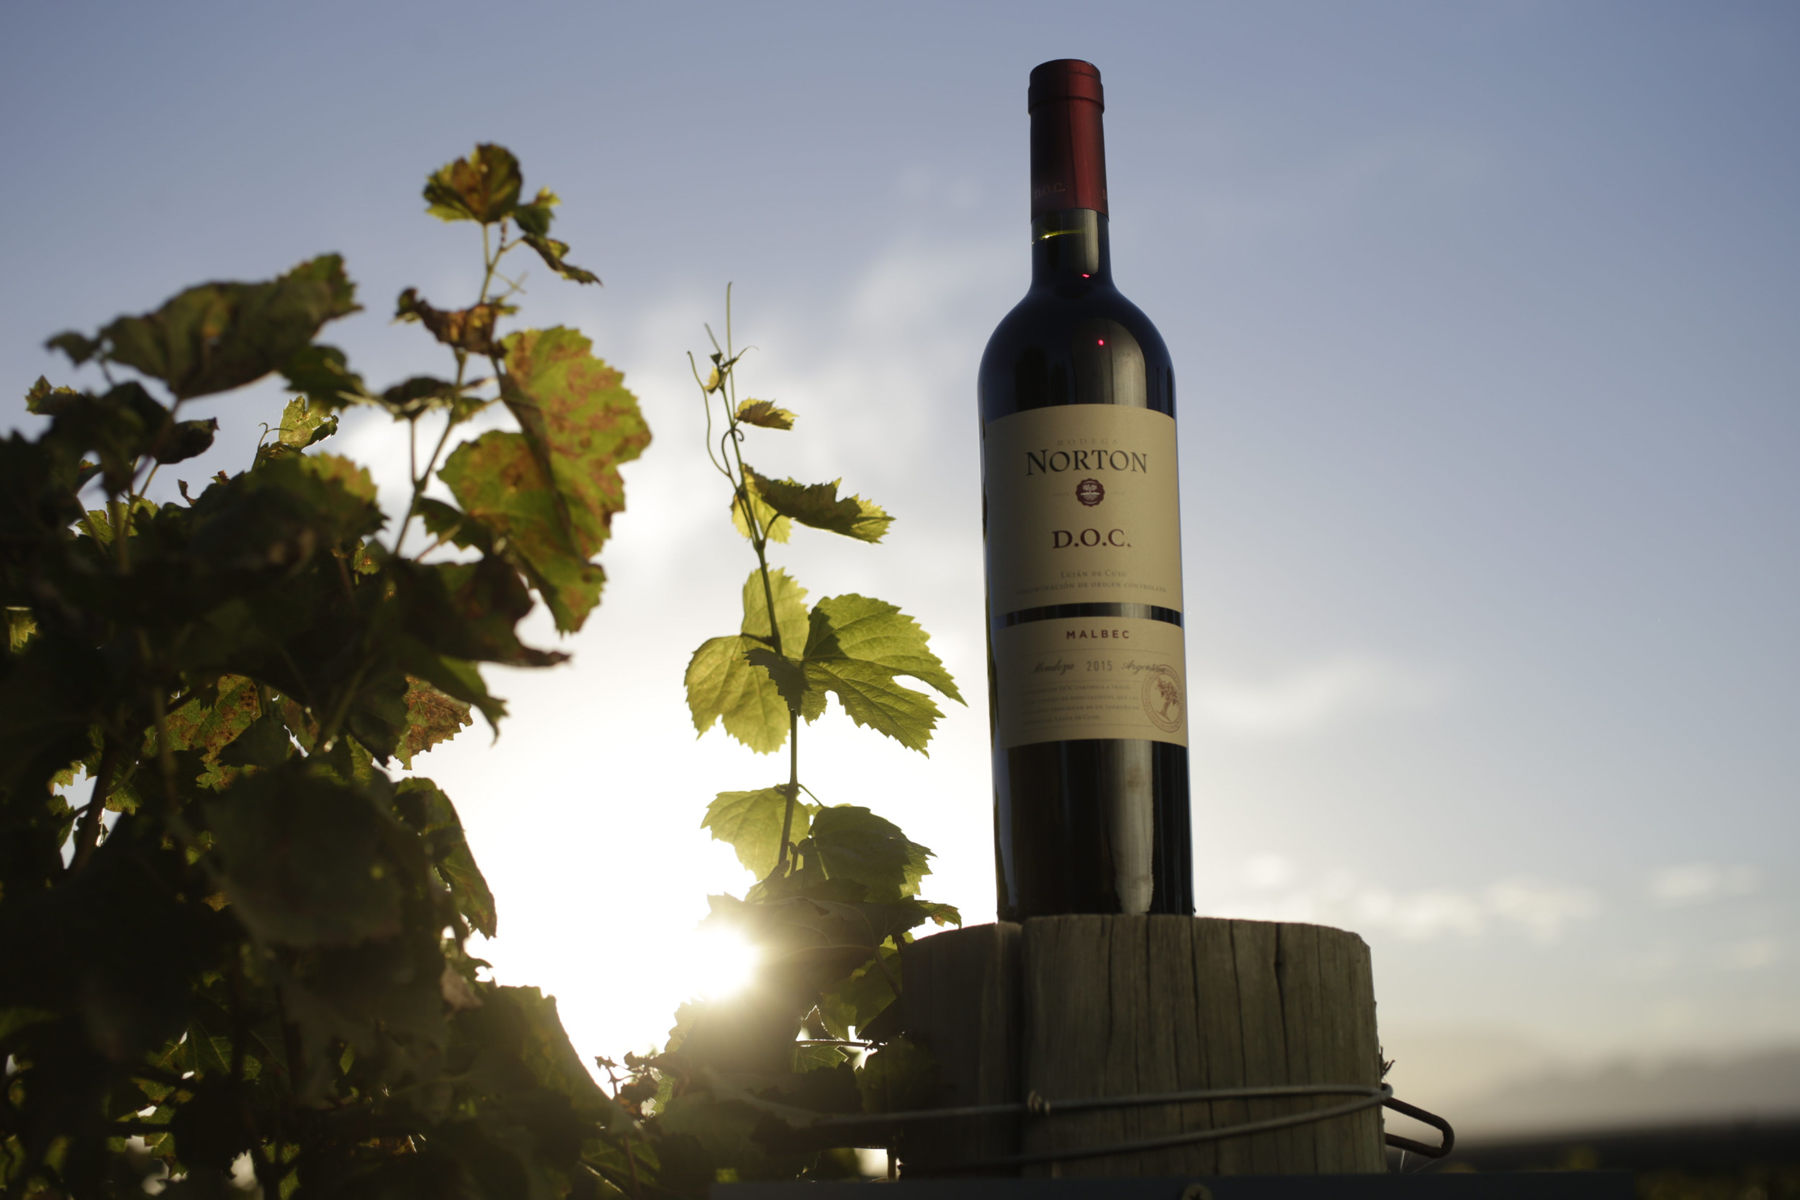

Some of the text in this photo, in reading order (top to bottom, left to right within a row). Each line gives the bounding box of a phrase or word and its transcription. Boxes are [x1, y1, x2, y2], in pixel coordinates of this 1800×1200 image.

[1024, 449, 1148, 476] NORTON
[1051, 528, 1132, 549] D.O.C.
[1066, 630, 1130, 640] MALBEC
[1086, 661, 1113, 672] 2015
